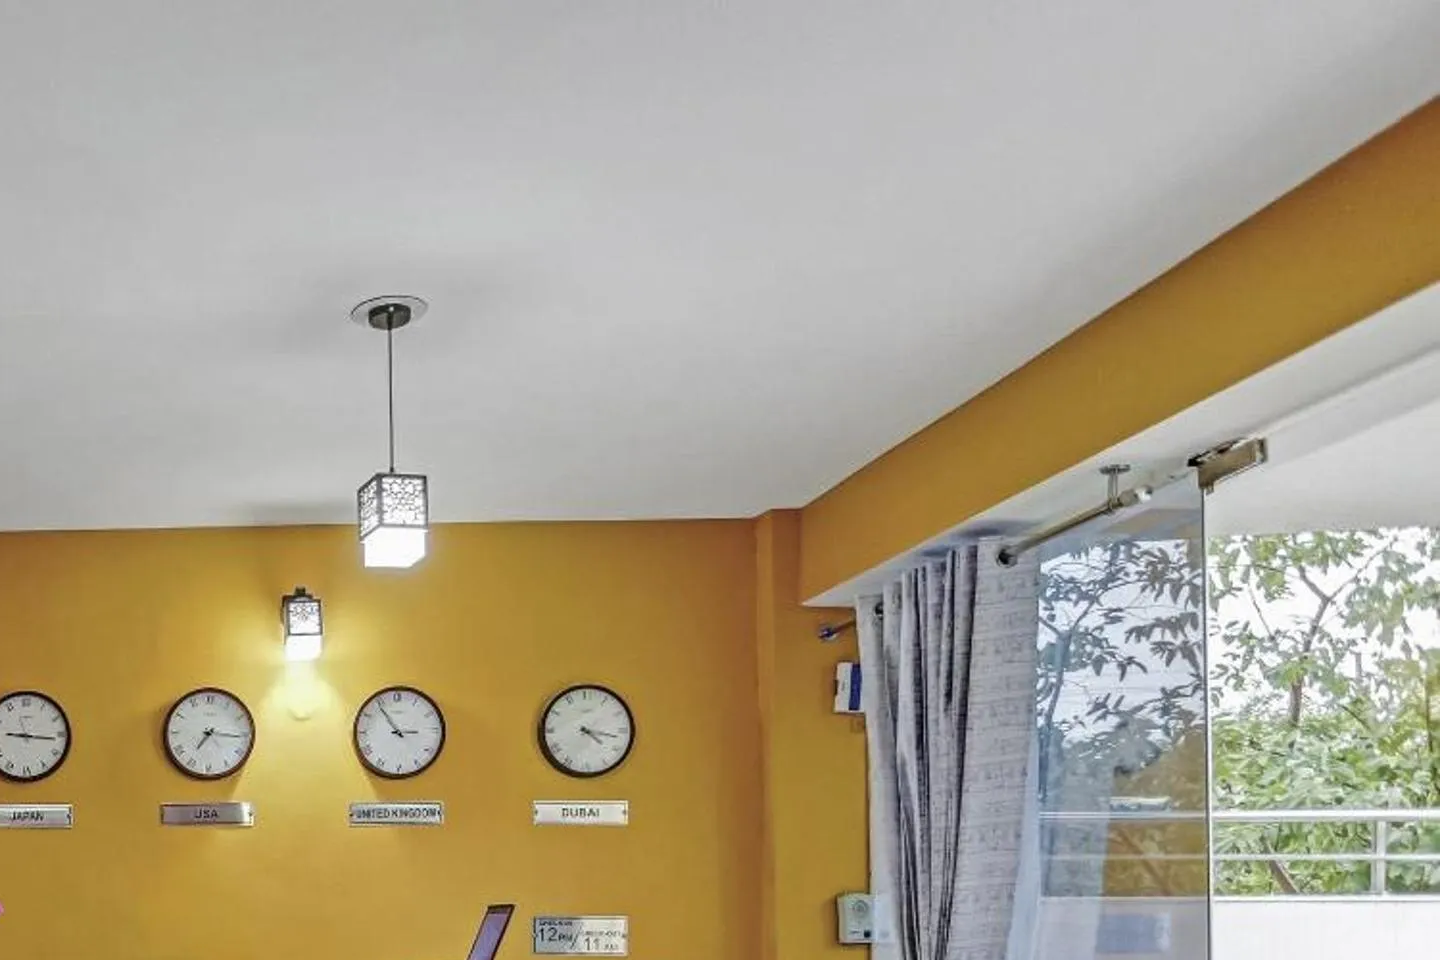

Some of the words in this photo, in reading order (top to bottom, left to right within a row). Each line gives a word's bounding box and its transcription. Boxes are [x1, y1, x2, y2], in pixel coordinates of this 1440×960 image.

[10, 810, 45, 822] JAPAN
[194, 808, 219, 819] USA
[355, 808, 390, 819] UNITED
[391, 808, 437, 819] KINGDOM
[561, 807, 601, 818] DUBAI
